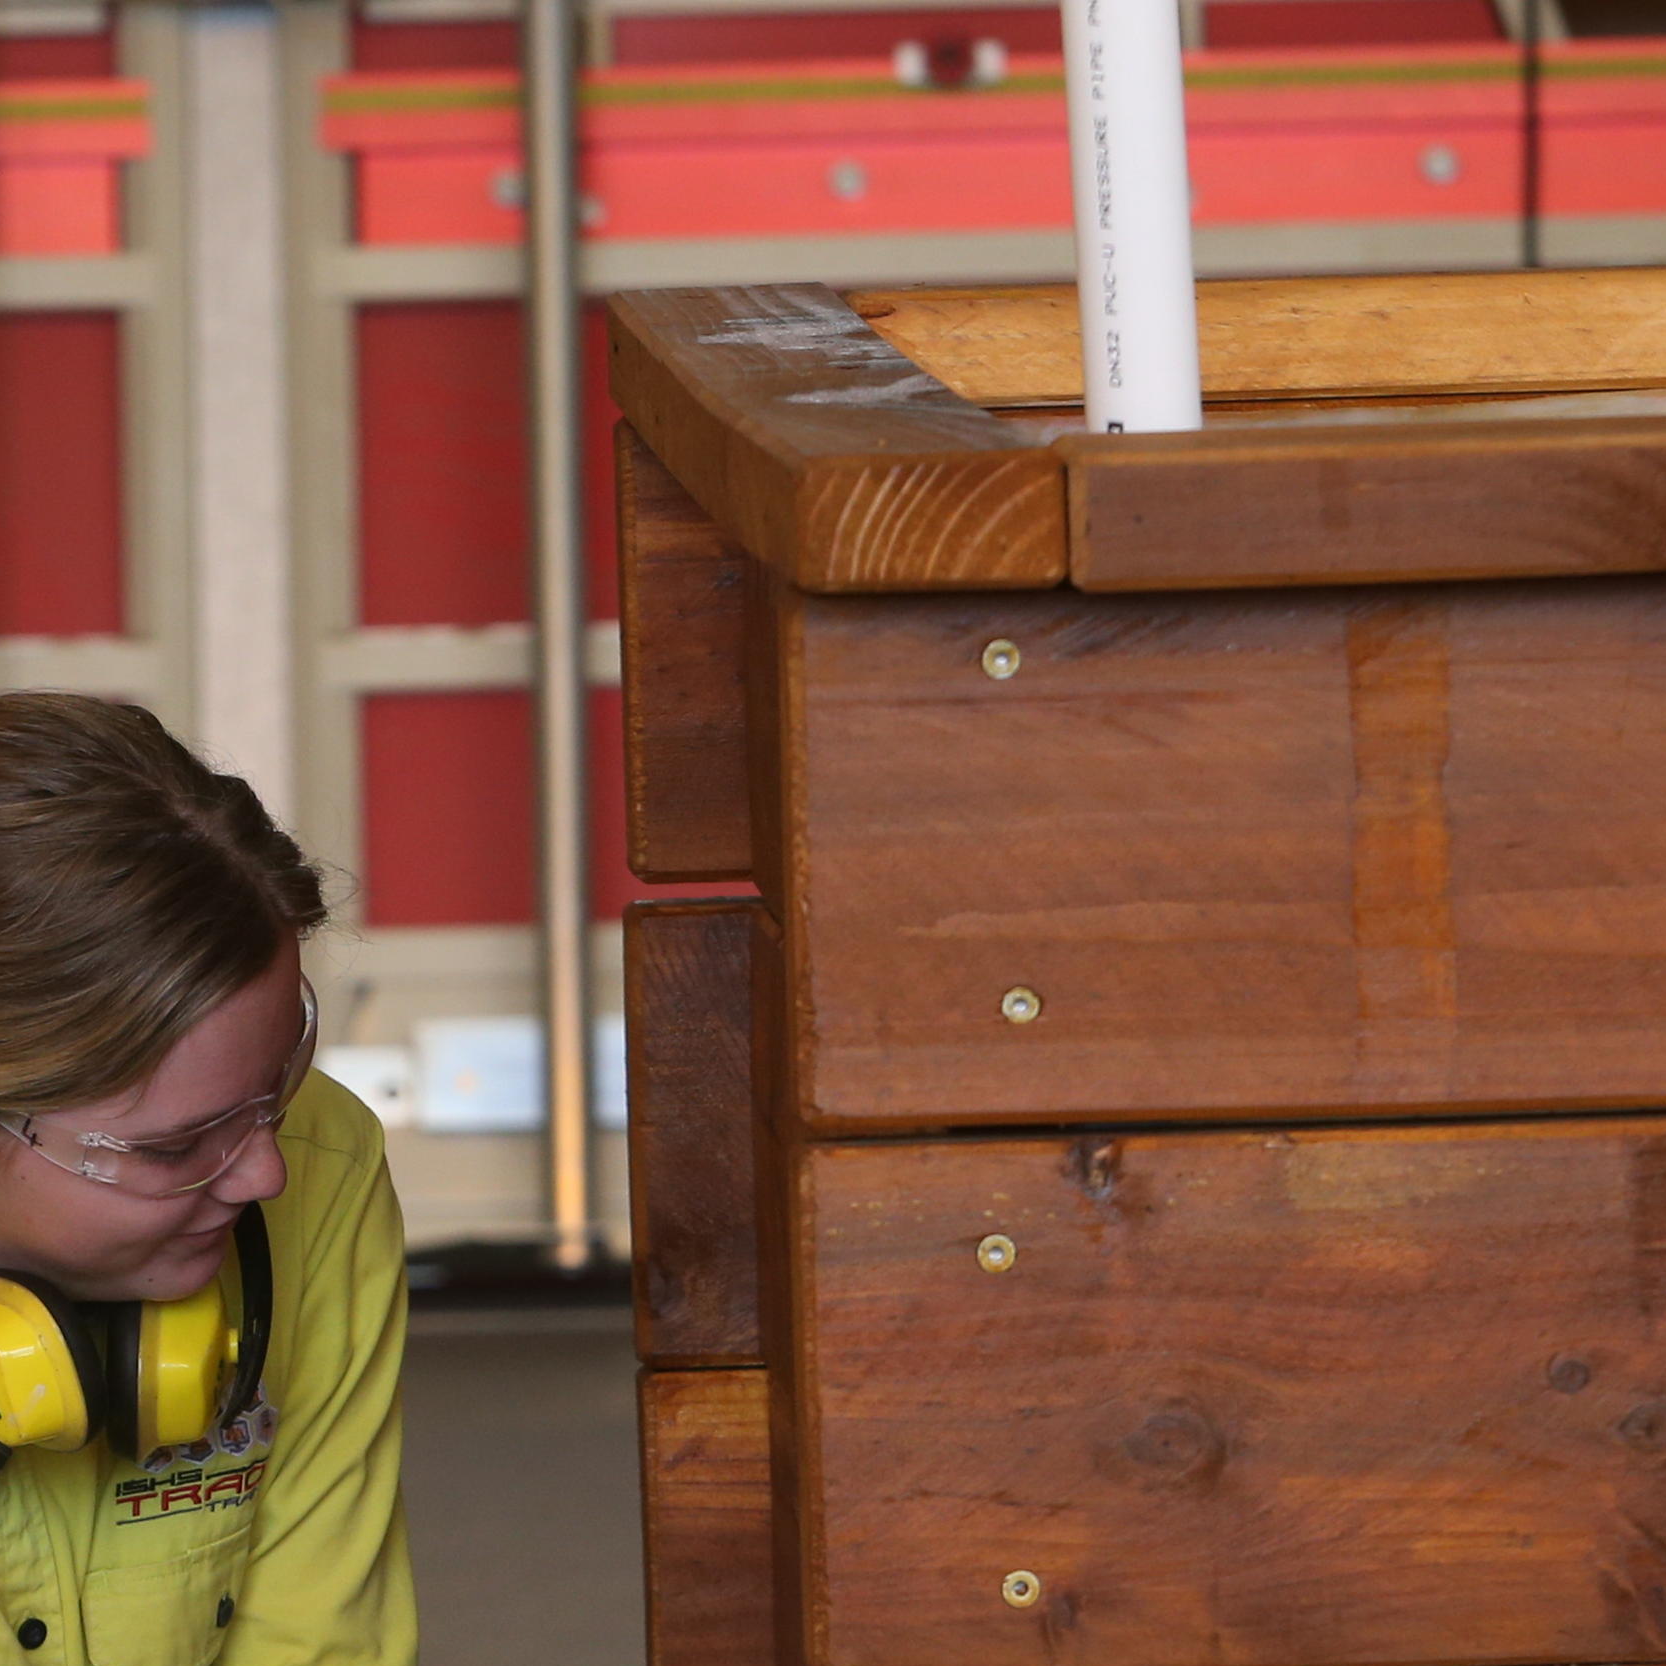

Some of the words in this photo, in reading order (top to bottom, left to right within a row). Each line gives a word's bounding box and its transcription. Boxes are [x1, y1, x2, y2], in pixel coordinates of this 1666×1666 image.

[1088, 41, 1105, 100] PIPE
[1094, 114, 1112, 229] PRESSURE
[1101, 243, 1117, 315] PVC-U
[1106, 331, 1123, 388] DN32
